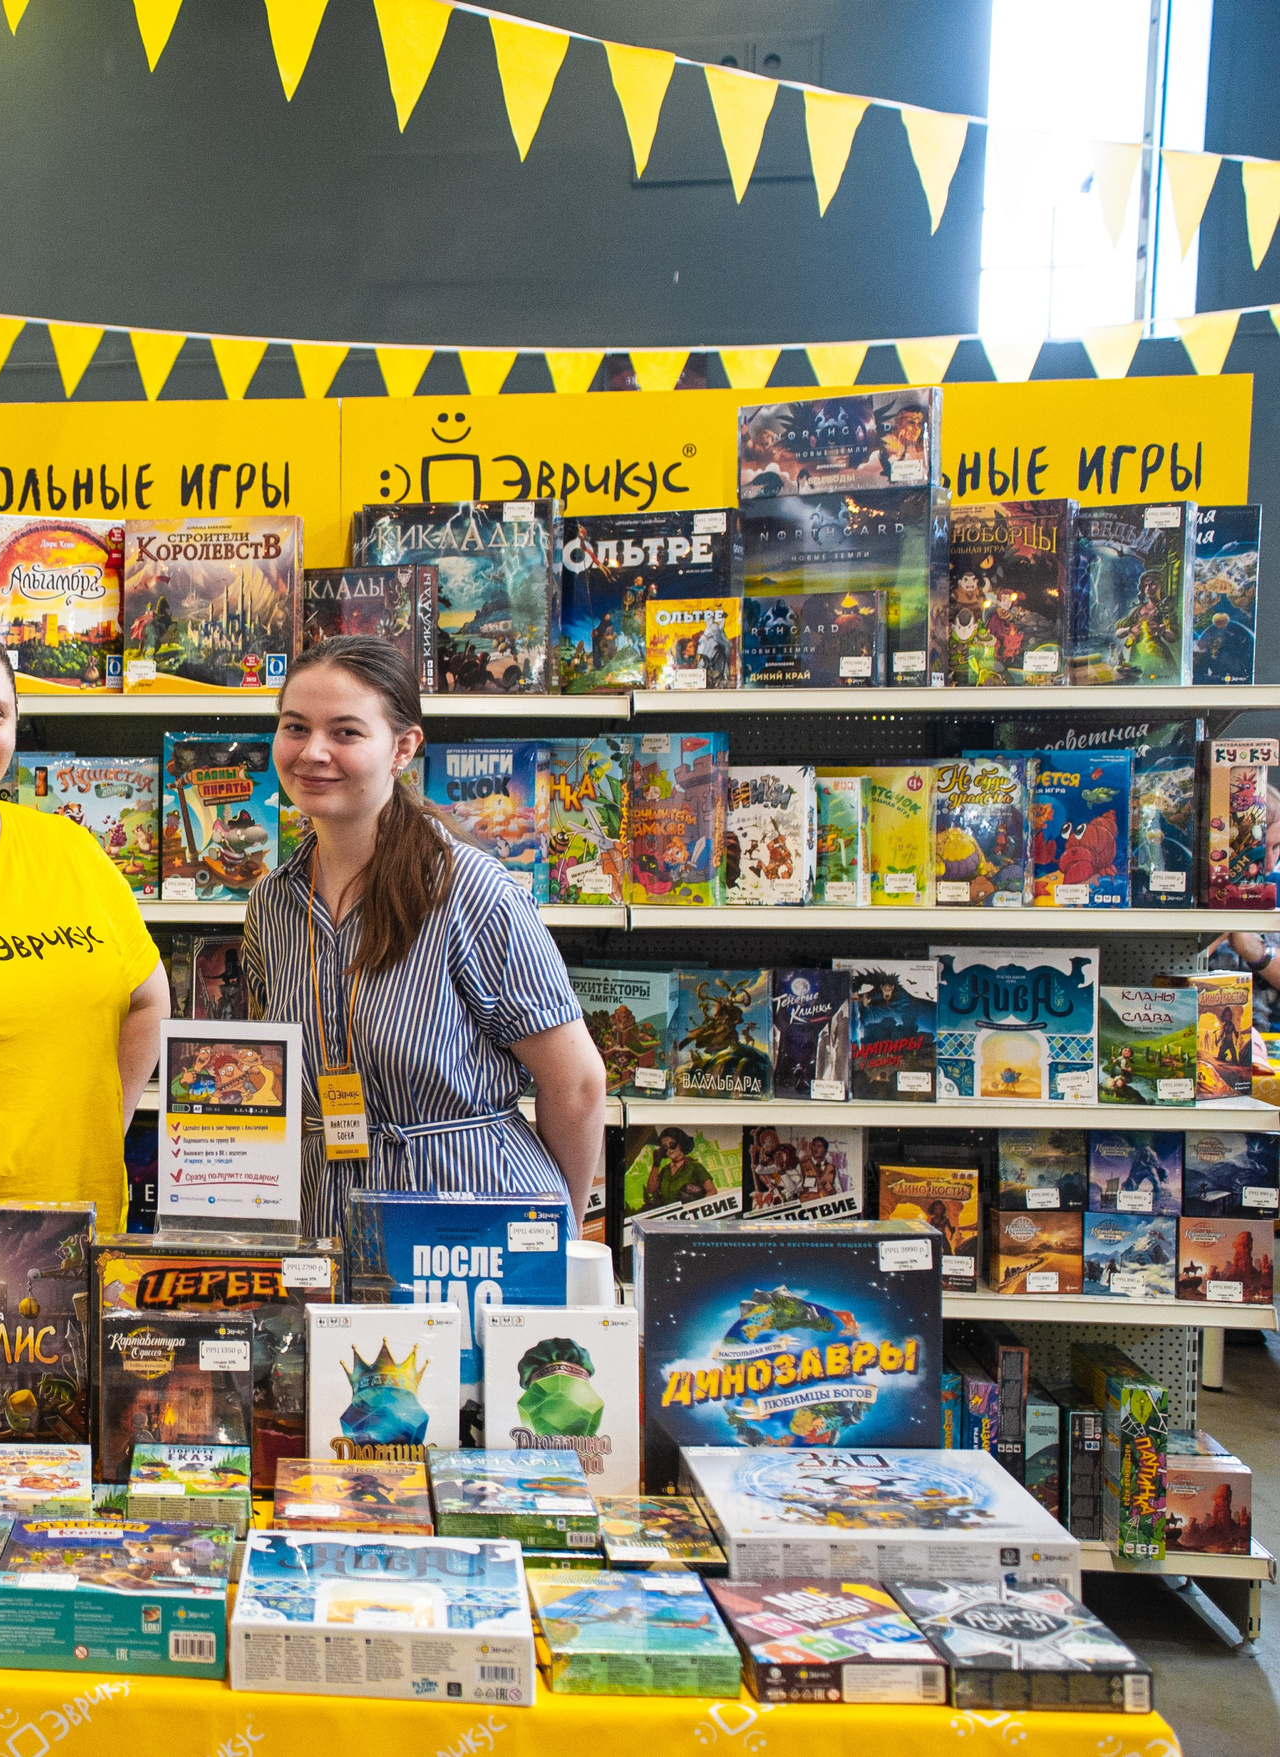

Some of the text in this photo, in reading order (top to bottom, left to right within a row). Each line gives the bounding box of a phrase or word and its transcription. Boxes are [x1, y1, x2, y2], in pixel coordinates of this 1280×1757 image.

[796, 446, 868, 459] НОВЫЕ ЗЕМЛИ
[1079, 442, 1203, 493] ИГРЫ
[181, 462, 291, 509] ИГРЫ
[492, 454, 690, 511] Эврикус
[167, 532, 250, 543] СТРОИТЕЛИ
[376, 516, 537, 552] КИКЛАДЫ
[951, 523, 1058, 554] НОБОРЦЫ
[136, 532, 282, 562] КОРОЛЕВСТВ
[562, 535, 715, 574] ОЛЬТРЕ
[983, 545, 1005, 553] ИГРА
[2, 563, 107, 606] Альгамбра
[304, 573, 385, 601] КЛАДЫ
[656, 606, 725, 626] ОЛЬТРЕ
[751, 624, 840, 635] RTHGARD
[750, 668, 811, 682] ДИКИЙ КРАЙ
[1043, 722, 1150, 752] осветная
[446, 753, 512, 777] ПИНГИ
[203, 781, 251, 796] ПИРАТЫ
[446, 776, 511, 801] СКОК
[589, 995, 623, 1005] АМИТИС
[1121, 989, 1176, 1004] КЛАНЫ
[1121, 1012, 1175, 1024] СЛАВА
[185, 1172, 280, 1182] Сразу получите подарок!
[413, 1245, 504, 1279] ПОСЛЕ
[108, 1333, 186, 1351] Картавентура
[718, 1342, 784, 1358] НАСТОЛЬНАЯ ИГРА
[661, 1338, 919, 1408] ДИНОЗАВРЫ
[763, 1387, 873, 1411] ЛЮБИМЦЫ БОГОВ
[35, 1520, 143, 1532] ДЕТЕКТИВ
[144, 1623, 160, 1631] LOKI
